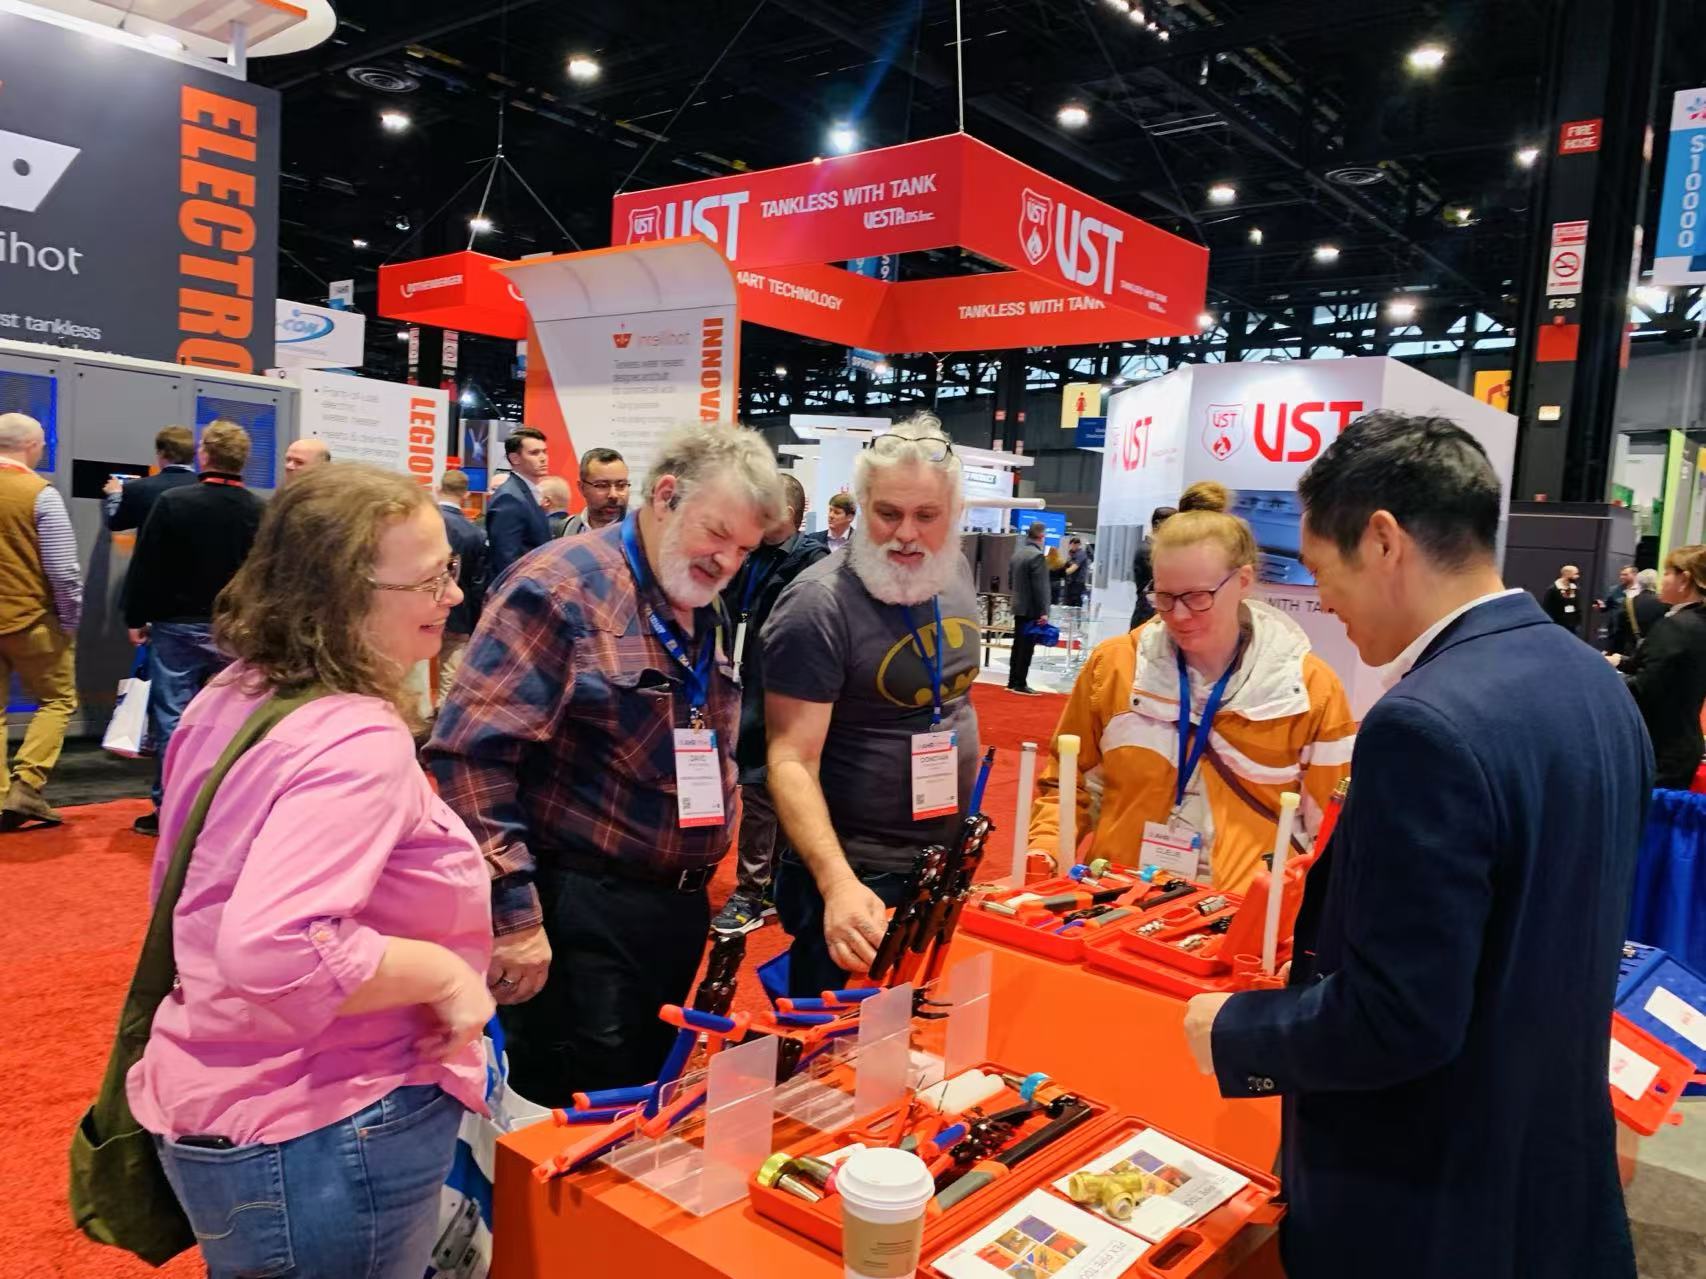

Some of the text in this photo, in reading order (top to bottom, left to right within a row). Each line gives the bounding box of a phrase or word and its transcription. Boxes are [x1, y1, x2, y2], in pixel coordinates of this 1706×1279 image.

[760, 173, 937, 219] TANKLESS WITH TANK
[1056, 202, 1124, 295] UST
[768, 278, 844, 310] TECHNOLOGY
[958, 302, 1026, 319] TANKLESS
[1029, 299, 1064, 314] WITH
[1122, 416, 1152, 471] UST
[1212, 413, 1238, 428] UST
[1253, 401, 1364, 462] UST
